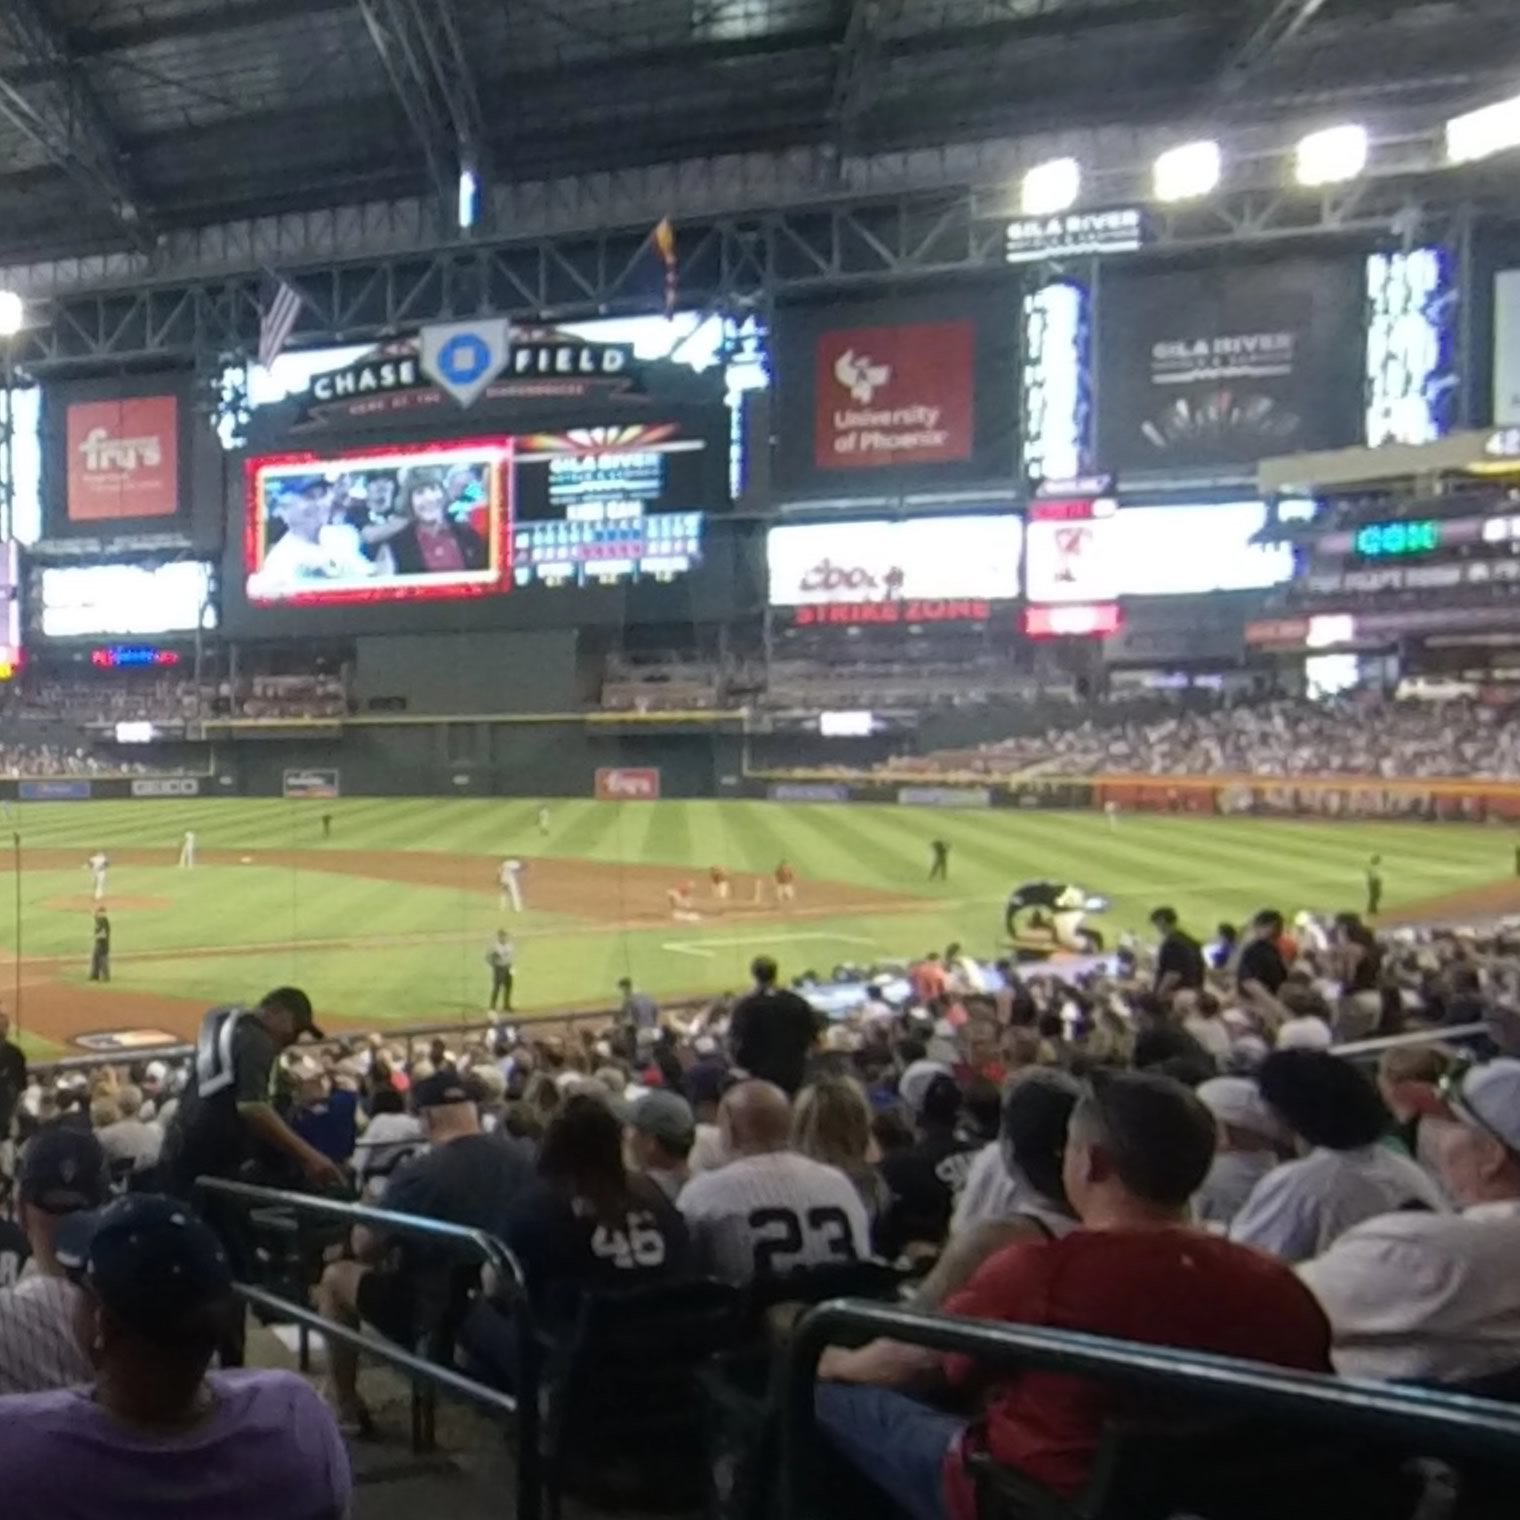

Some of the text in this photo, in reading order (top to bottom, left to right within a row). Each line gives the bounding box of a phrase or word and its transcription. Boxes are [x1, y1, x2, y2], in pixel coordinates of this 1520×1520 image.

[1006, 216, 1063, 239] GILA
[1065, 209, 1140, 232] RIVER
[1151, 332, 1292, 359] GILA RIVER
[314, 348, 626, 400] CHASE FIELD
[833, 404, 941, 430] University
[833, 430, 949, 452] of Phoenix
[793, 597, 991, 625] STRIKE ZONE
[591, 1210, 666, 1270] 46
[748, 1206, 855, 1272] 23
